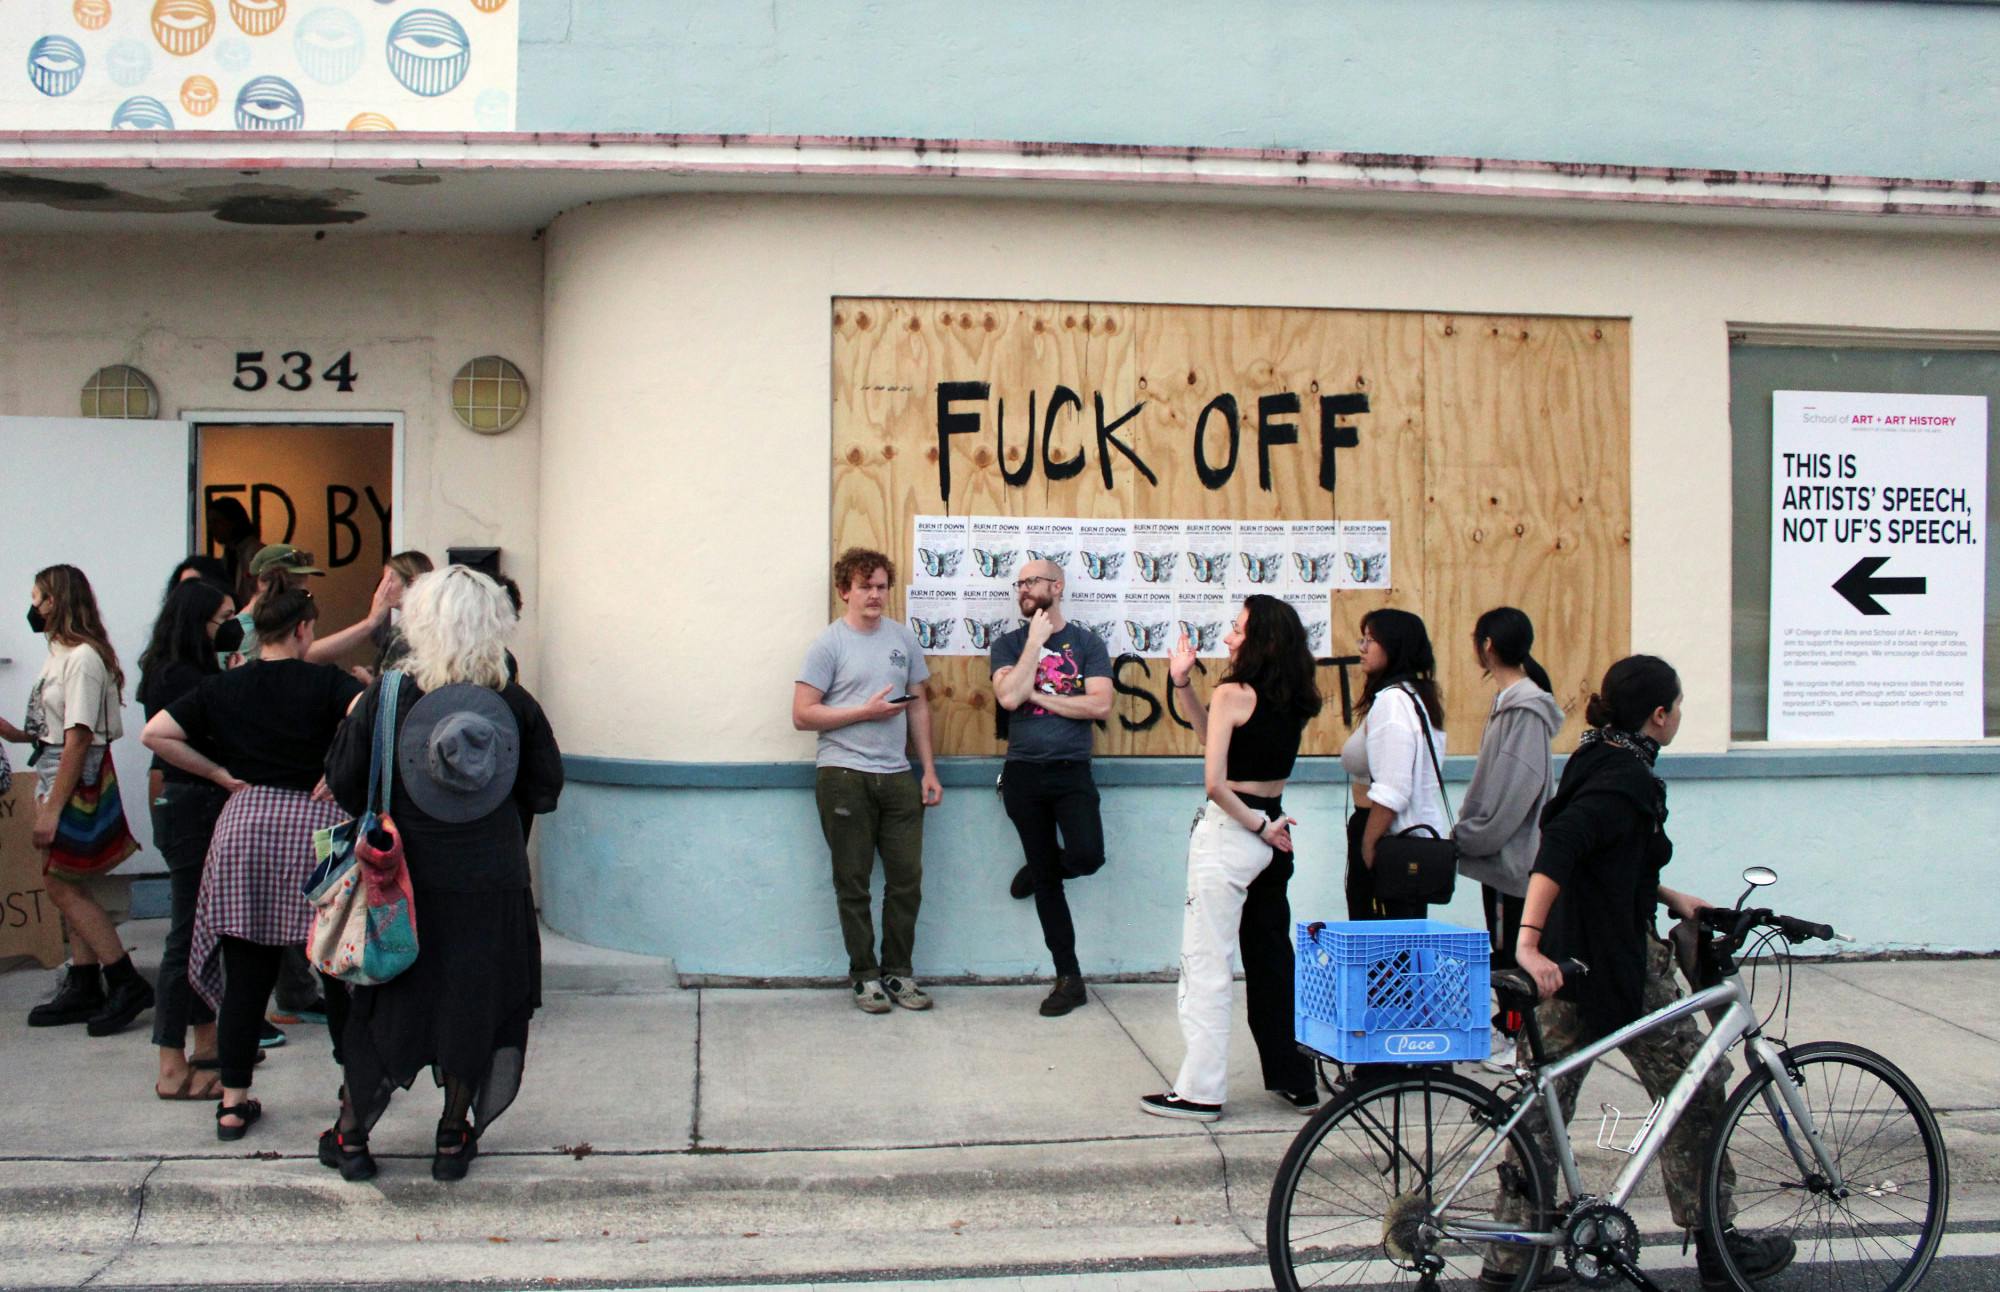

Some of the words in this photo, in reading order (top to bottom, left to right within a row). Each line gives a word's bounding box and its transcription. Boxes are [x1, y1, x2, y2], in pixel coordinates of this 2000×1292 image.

[233, 351, 358, 392] 534
[1803, 413, 1835, 424] School
[1852, 415, 1873, 424] ART
[1884, 416, 1906, 425] ART
[1909, 416, 1956, 426] HISTORY
[937, 381, 1158, 504] FUCK
[1193, 391, 1370, 493] OFF
[1783, 453, 1831, 478] THIS
[1838, 454, 1857, 479] IS
[1782, 486, 1876, 511] ARTISTS'
[1882, 488, 1972, 516] SPEECH,
[1783, 518, 1828, 543] NOT
[1835, 518, 1881, 544] UF'S
[1888, 520, 1977, 544] SPEECH.
[1398, 1036, 1437, 1052] Pace
